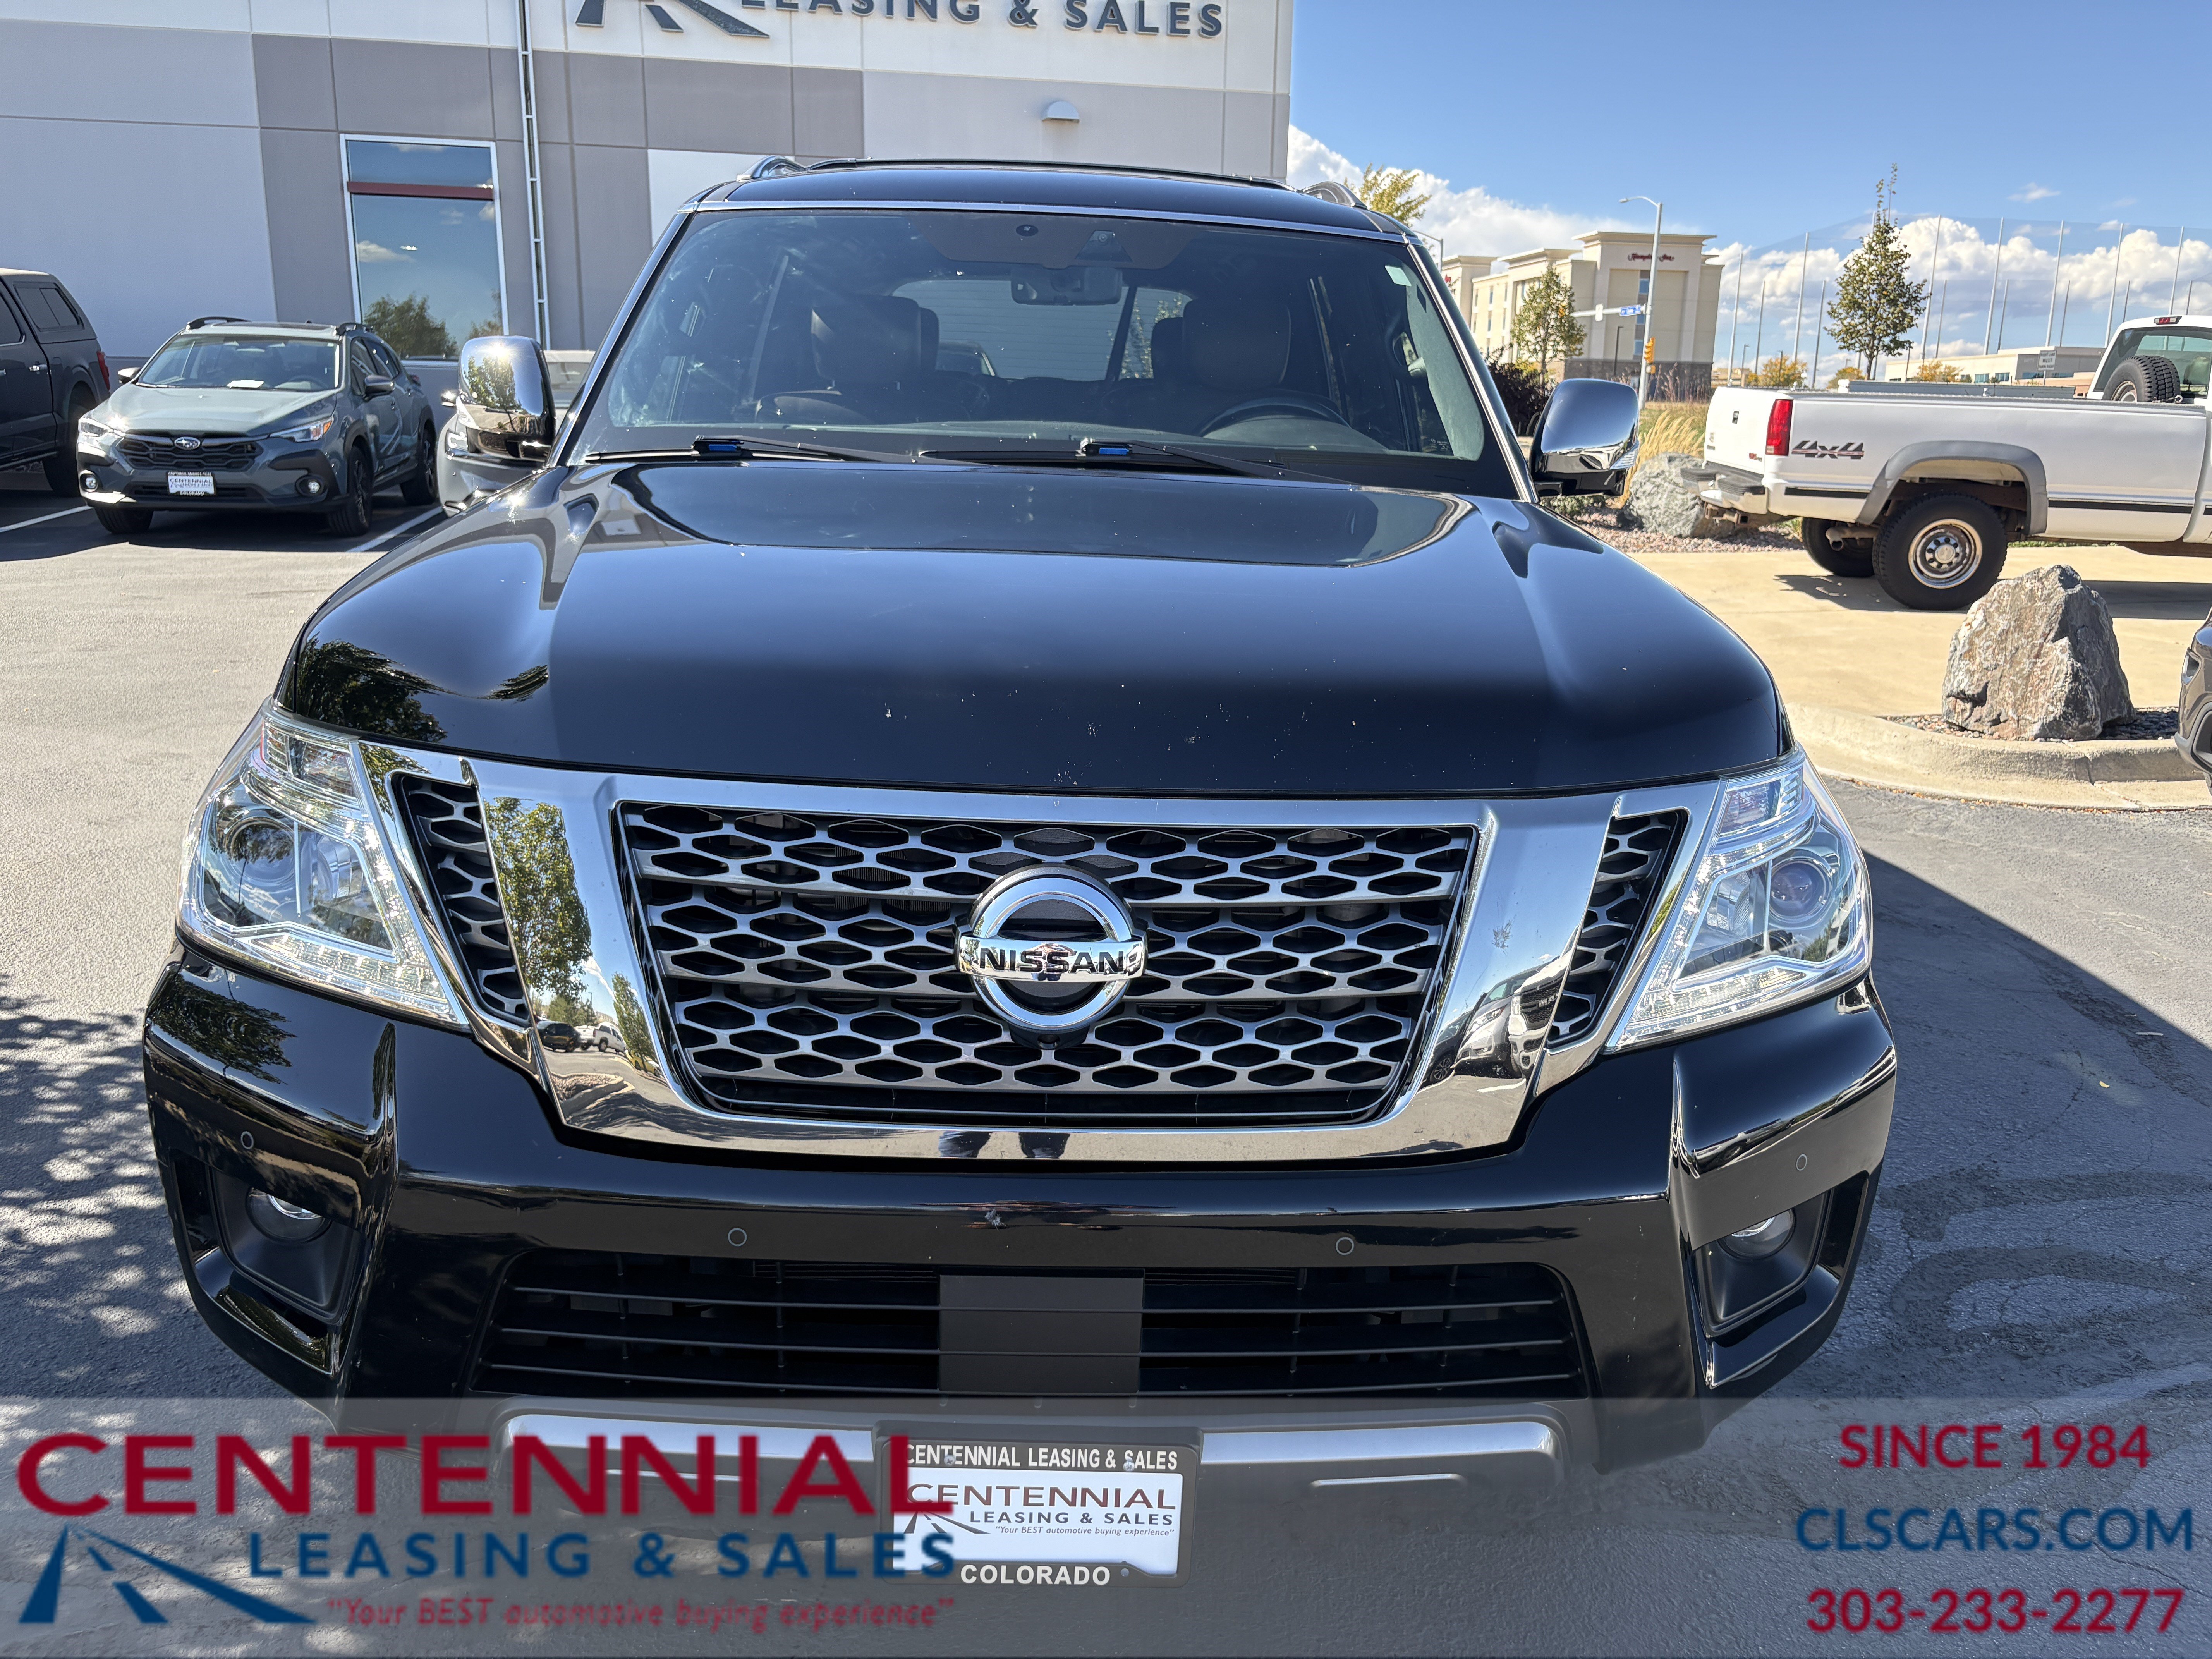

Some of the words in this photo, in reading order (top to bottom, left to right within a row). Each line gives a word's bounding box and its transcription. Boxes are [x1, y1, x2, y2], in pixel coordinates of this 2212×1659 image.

[1008, 0, 1039, 27] &
[1064, 0, 1222, 37] SALES
[979, 947, 1125, 974] NISSAN
[907, 1444, 1021, 1467] CENTENNIAL
[1028, 1448, 1100, 1468] LEASING
[1105, 1449, 1116, 1468] &
[1124, 1450, 1178, 1470] SALES
[907, 1483, 1176, 1510] CENTENNIAL
[970, 1511, 1068, 1523] LEASING
[1080, 1512, 1093, 1523] &
[1104, 1512, 1173, 1525] SALES
[1095, 1527, 1121, 1536] buying
[960, 1564, 1110, 1585] COLORADO
